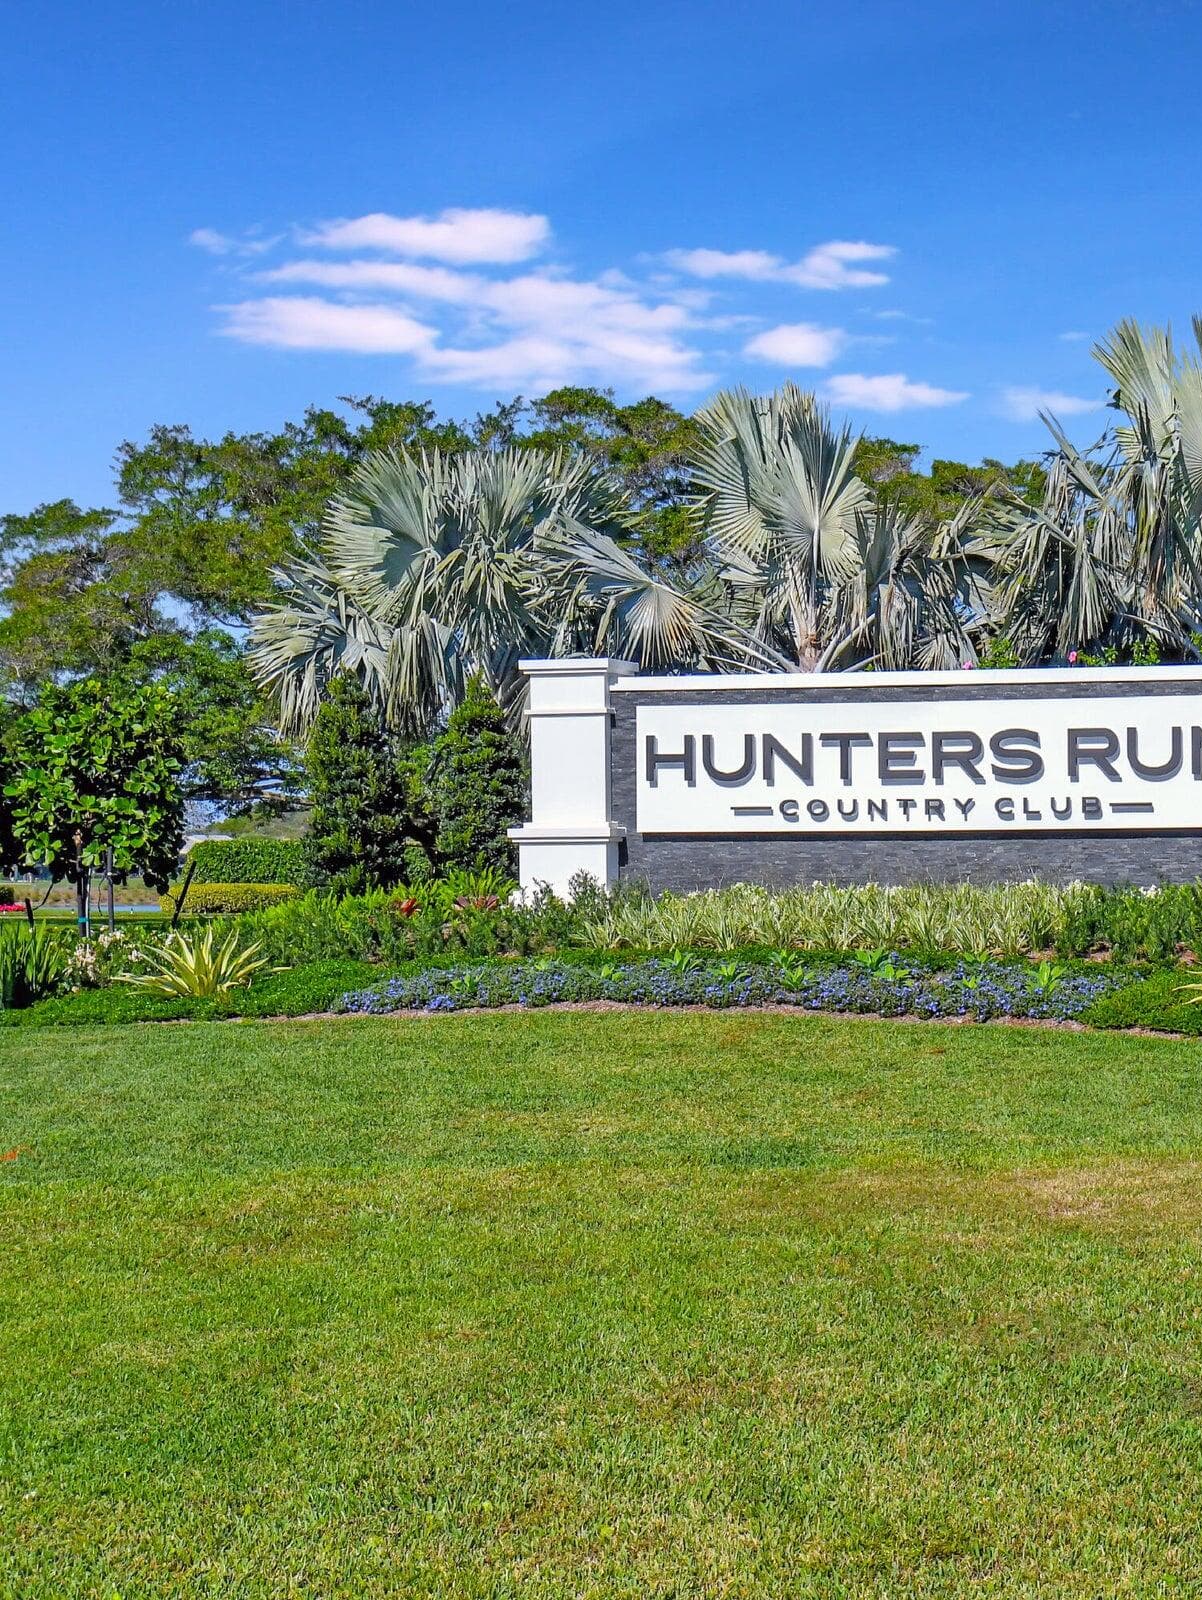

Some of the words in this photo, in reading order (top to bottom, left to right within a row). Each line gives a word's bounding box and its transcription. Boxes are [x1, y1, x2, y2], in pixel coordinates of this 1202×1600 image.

[645, 728, 1045, 788] HUNTERS
[779, 797, 976, 823] COUNTRY
[994, 796, 1103, 822] CLUB
